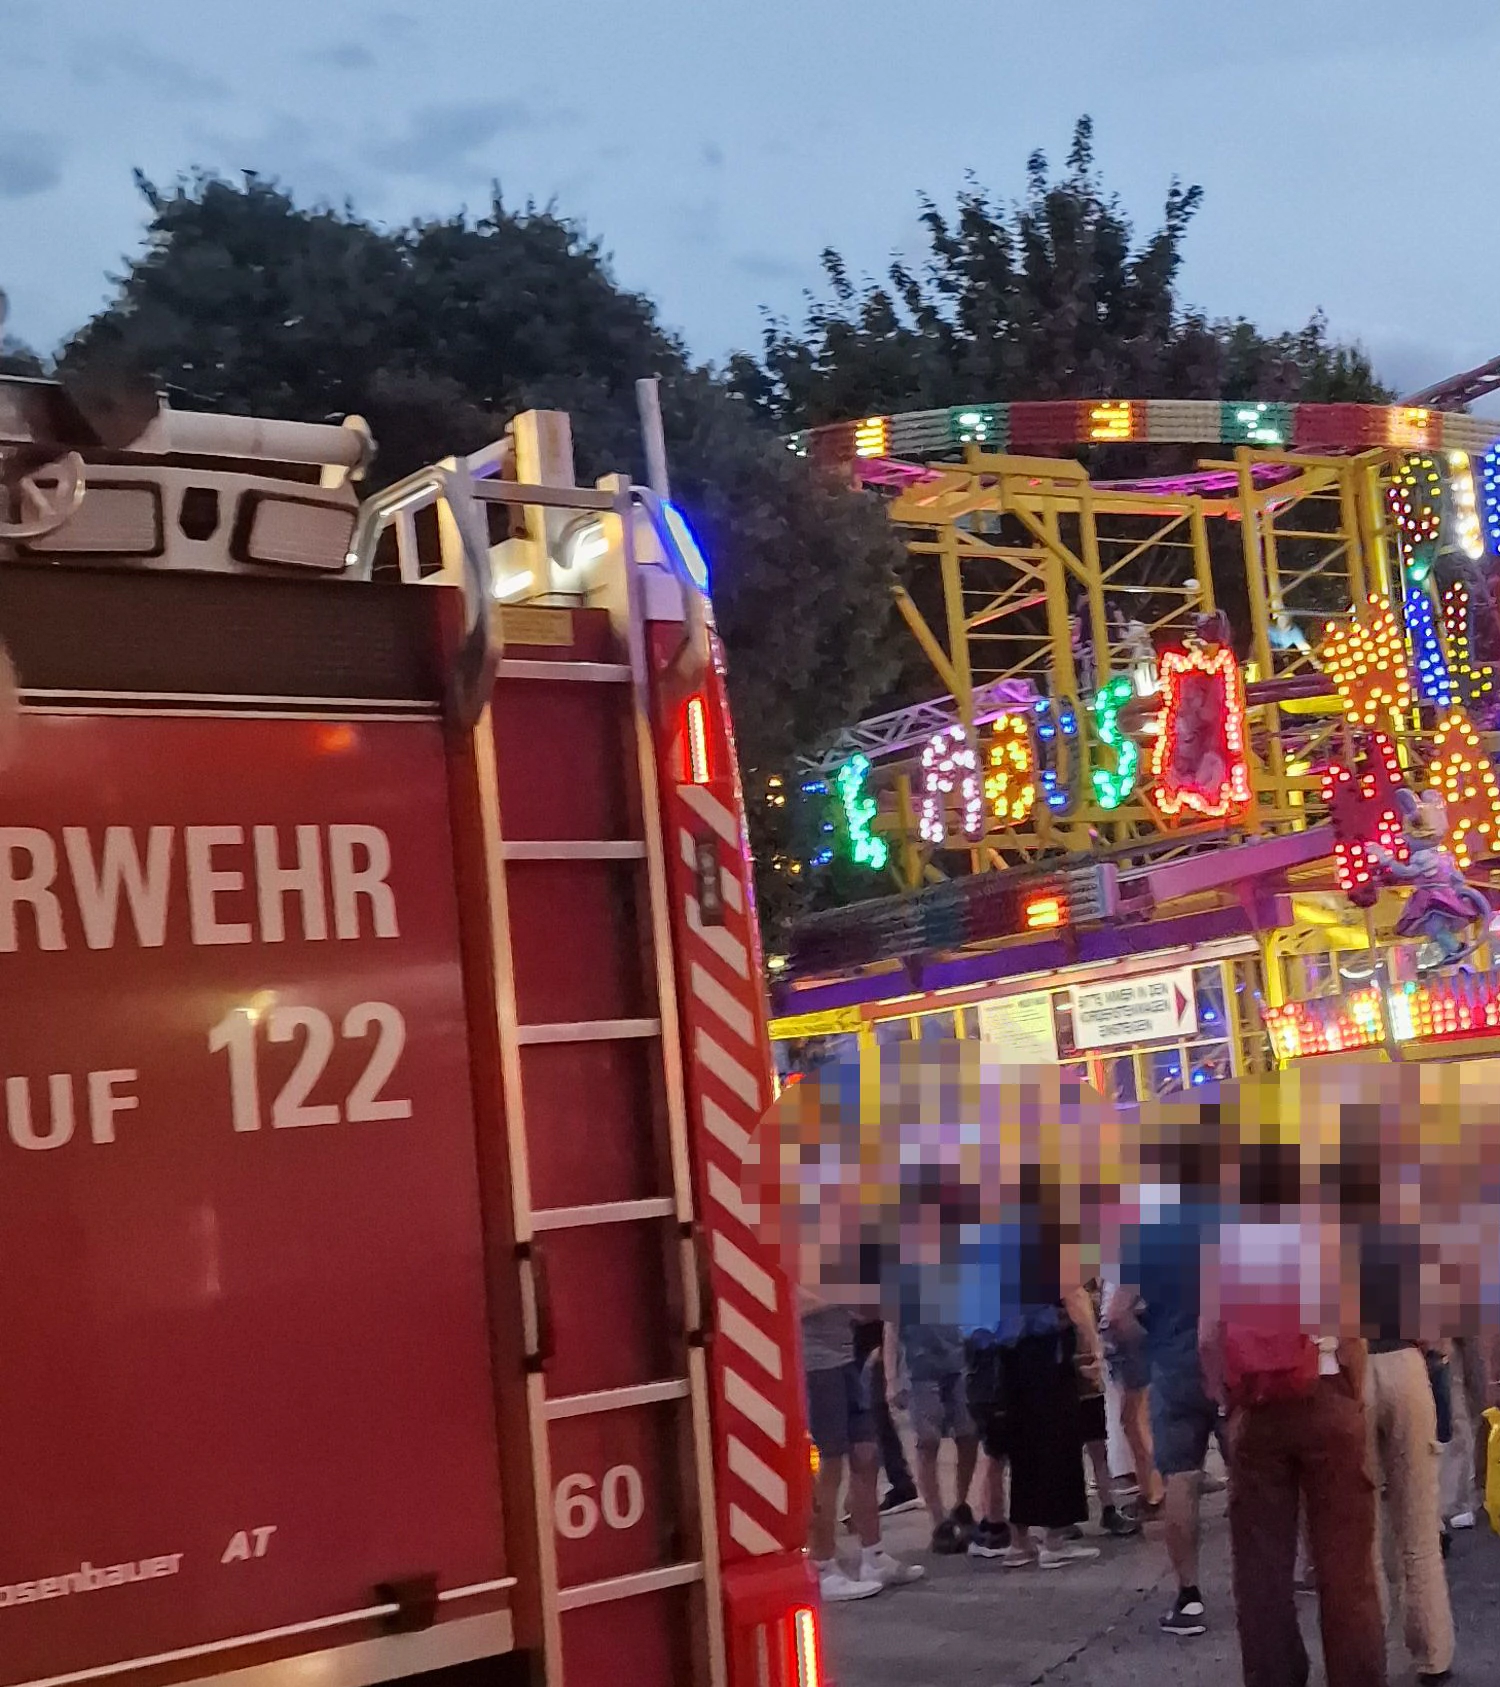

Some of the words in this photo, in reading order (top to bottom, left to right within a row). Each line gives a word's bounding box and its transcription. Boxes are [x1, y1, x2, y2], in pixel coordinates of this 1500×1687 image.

[6, 1068, 139, 1150] UF
[208, 1001, 412, 1132] 122
[553, 1464, 645, 1539] 60
[220, 1525, 278, 1564] AT
